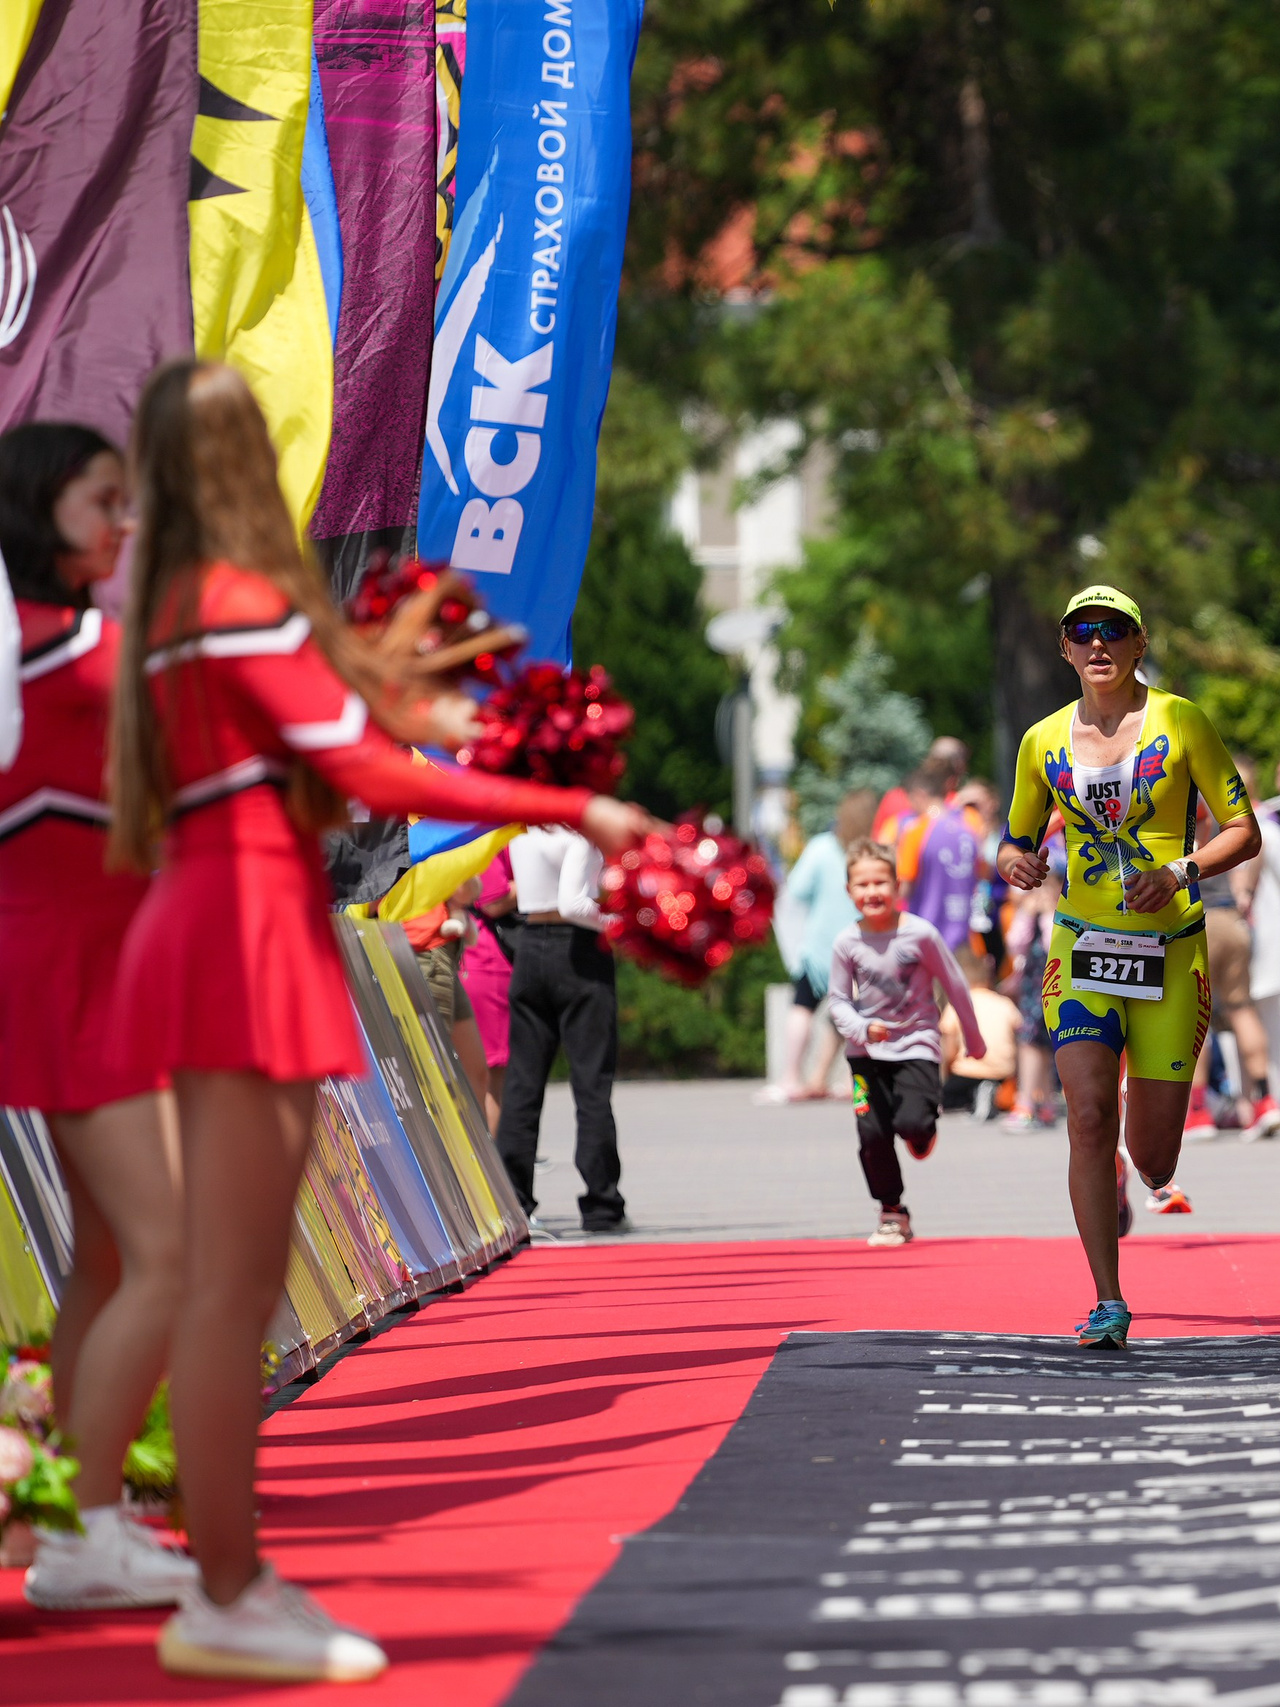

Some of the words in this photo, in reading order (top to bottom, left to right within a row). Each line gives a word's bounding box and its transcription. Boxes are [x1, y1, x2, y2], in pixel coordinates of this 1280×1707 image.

[541, 0, 575, 90] ДОМ
[529, 99, 568, 335] СТРАХОВОЙ
[448, 332, 554, 575] ВСК
[1085, 780, 1121, 801] JUST
[1089, 956, 1145, 982] 3271
